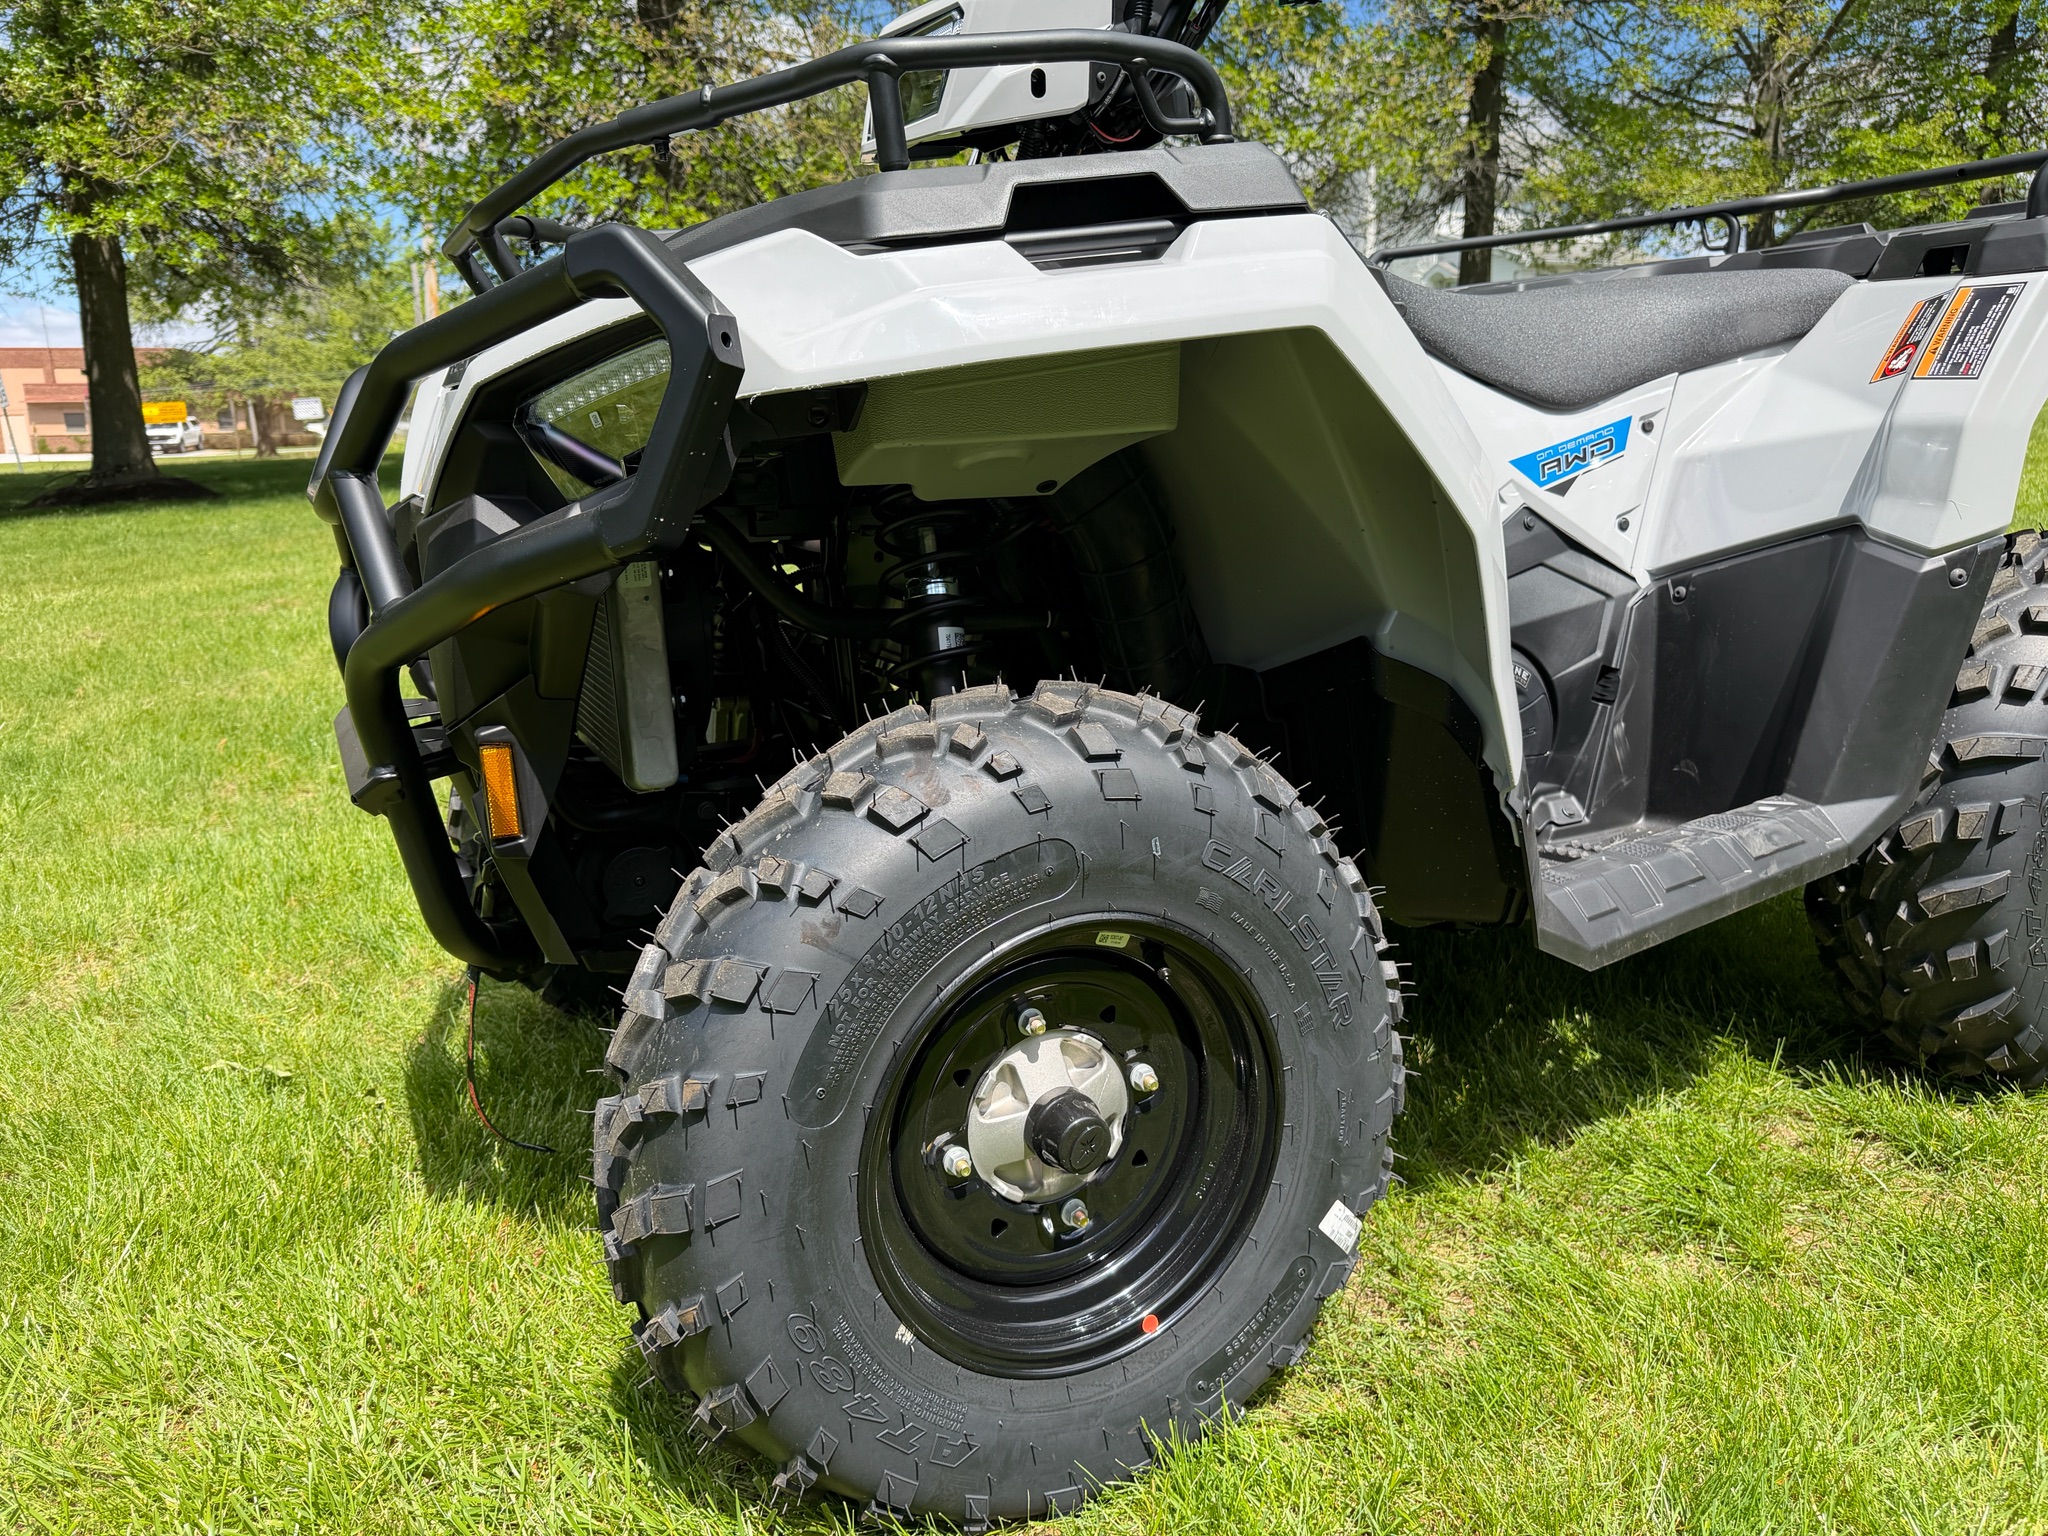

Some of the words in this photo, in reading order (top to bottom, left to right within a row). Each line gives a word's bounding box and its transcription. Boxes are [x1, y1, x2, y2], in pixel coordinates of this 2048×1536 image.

[1934, 308, 1959, 348] WARNING
[1536, 450, 1553, 461] ON
[1558, 426, 1614, 452] DEMAND
[1539, 437, 1615, 481] AWD
[825, 982, 855, 1019] 25
[934, 863, 988, 905] NHS
[1201, 838, 1354, 1031] CARLSTAR
[1230, 911, 1255, 936] MADE
[1264, 943, 1281, 965] THE
[826, 1009, 854, 1048] NOT
[849, 973, 879, 1010] FOR
[876, 910, 942, 975] HIGHWAY
[943, 870, 1010, 915] SERVICE
[832, 1020, 858, 1063] REDUCE
[854, 999, 872, 1021] THE
[868, 975, 889, 1000] RISK
[899, 928, 937, 964] SERIOUS
[1225, 1297, 1278, 1356] TUBELESS
[1283, 1291, 1300, 1314] PLY
[835, 1313, 874, 1365] OPERATING
[839, 1339, 864, 1369] LABEL
[786, 1313, 981, 1468] AT489
[860, 1366, 896, 1399] VEHICLE
[871, 1362, 889, 1381] FOR
[893, 1394, 913, 1410] SEE
